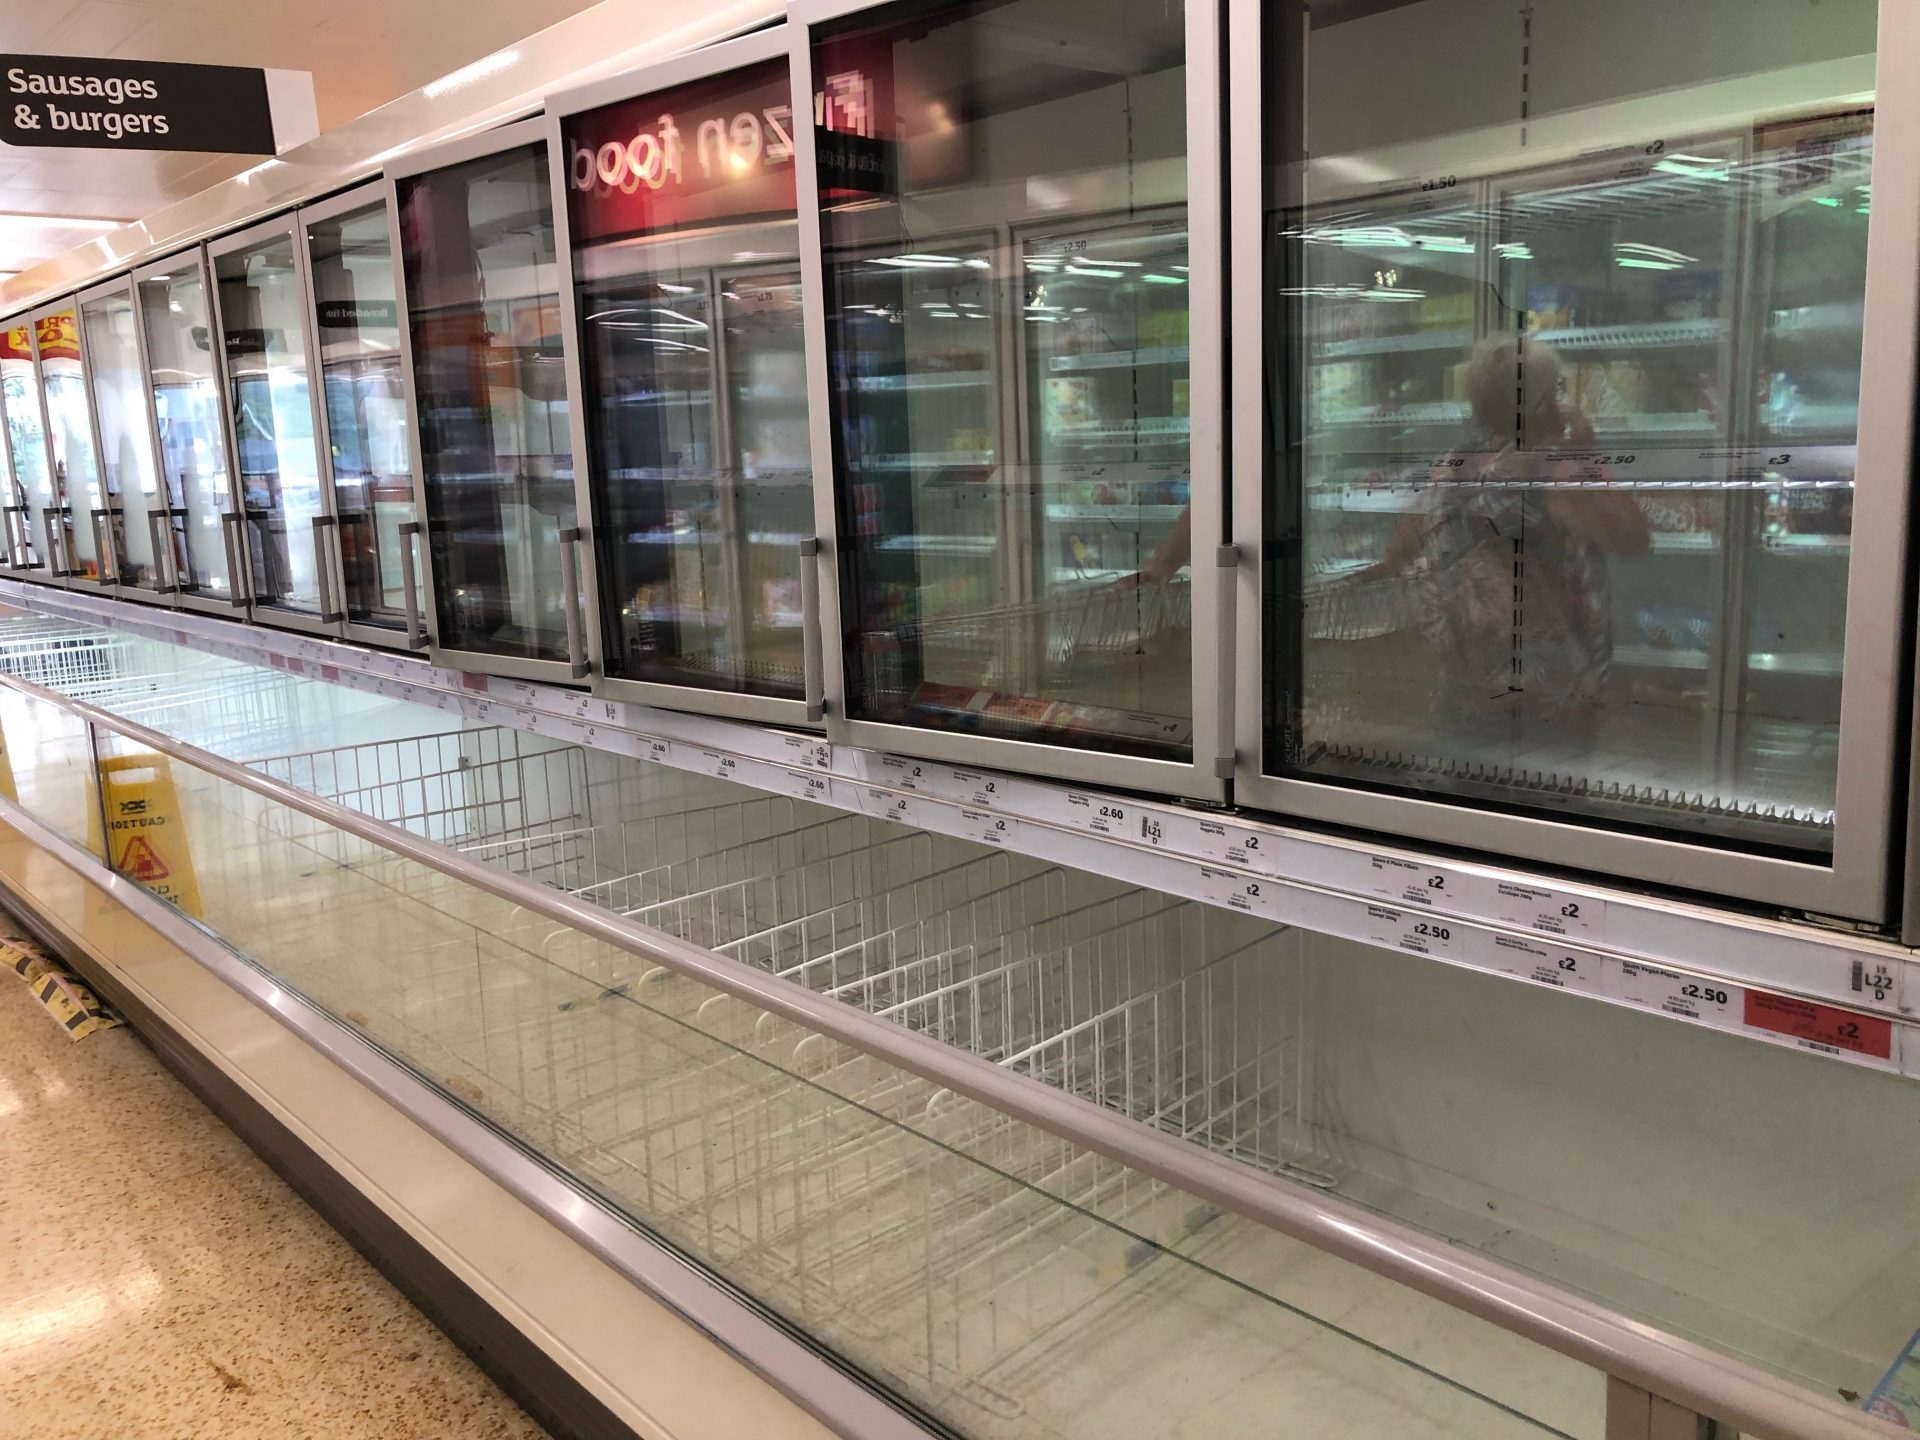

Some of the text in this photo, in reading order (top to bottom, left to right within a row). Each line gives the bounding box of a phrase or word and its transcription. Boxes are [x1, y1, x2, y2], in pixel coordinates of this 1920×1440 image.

[7, 68, 158, 104] Sausages
[14, 104, 170, 140] & burgers
[1645, 140, 1664, 155] £2
[1422, 174, 1457, 192] £1.50
[1594, 455, 1636, 465] £2.50
[1767, 453, 1791, 465] £3
[913, 766, 922, 777] £2
[986, 782, 996, 793] £2
[898, 799, 906, 810] £2
[1100, 806, 1124, 820] £2.60
[996, 820, 1006, 831] £2
[1148, 825, 1161, 838] L21
[1245, 836, 1259, 849] £2
[1428, 875, 1445, 890] £2
[1247, 884, 1260, 897] £2
[1561, 903, 1579, 919] £2
[1414, 923, 1450, 940] £2.50
[1558, 956, 1577, 972] £2
[1865, 972, 1892, 990] L22
[1681, 983, 1728, 1005] £2.50
[1875, 989, 1885, 1000] D
[1837, 1021, 1859, 1040] £2
